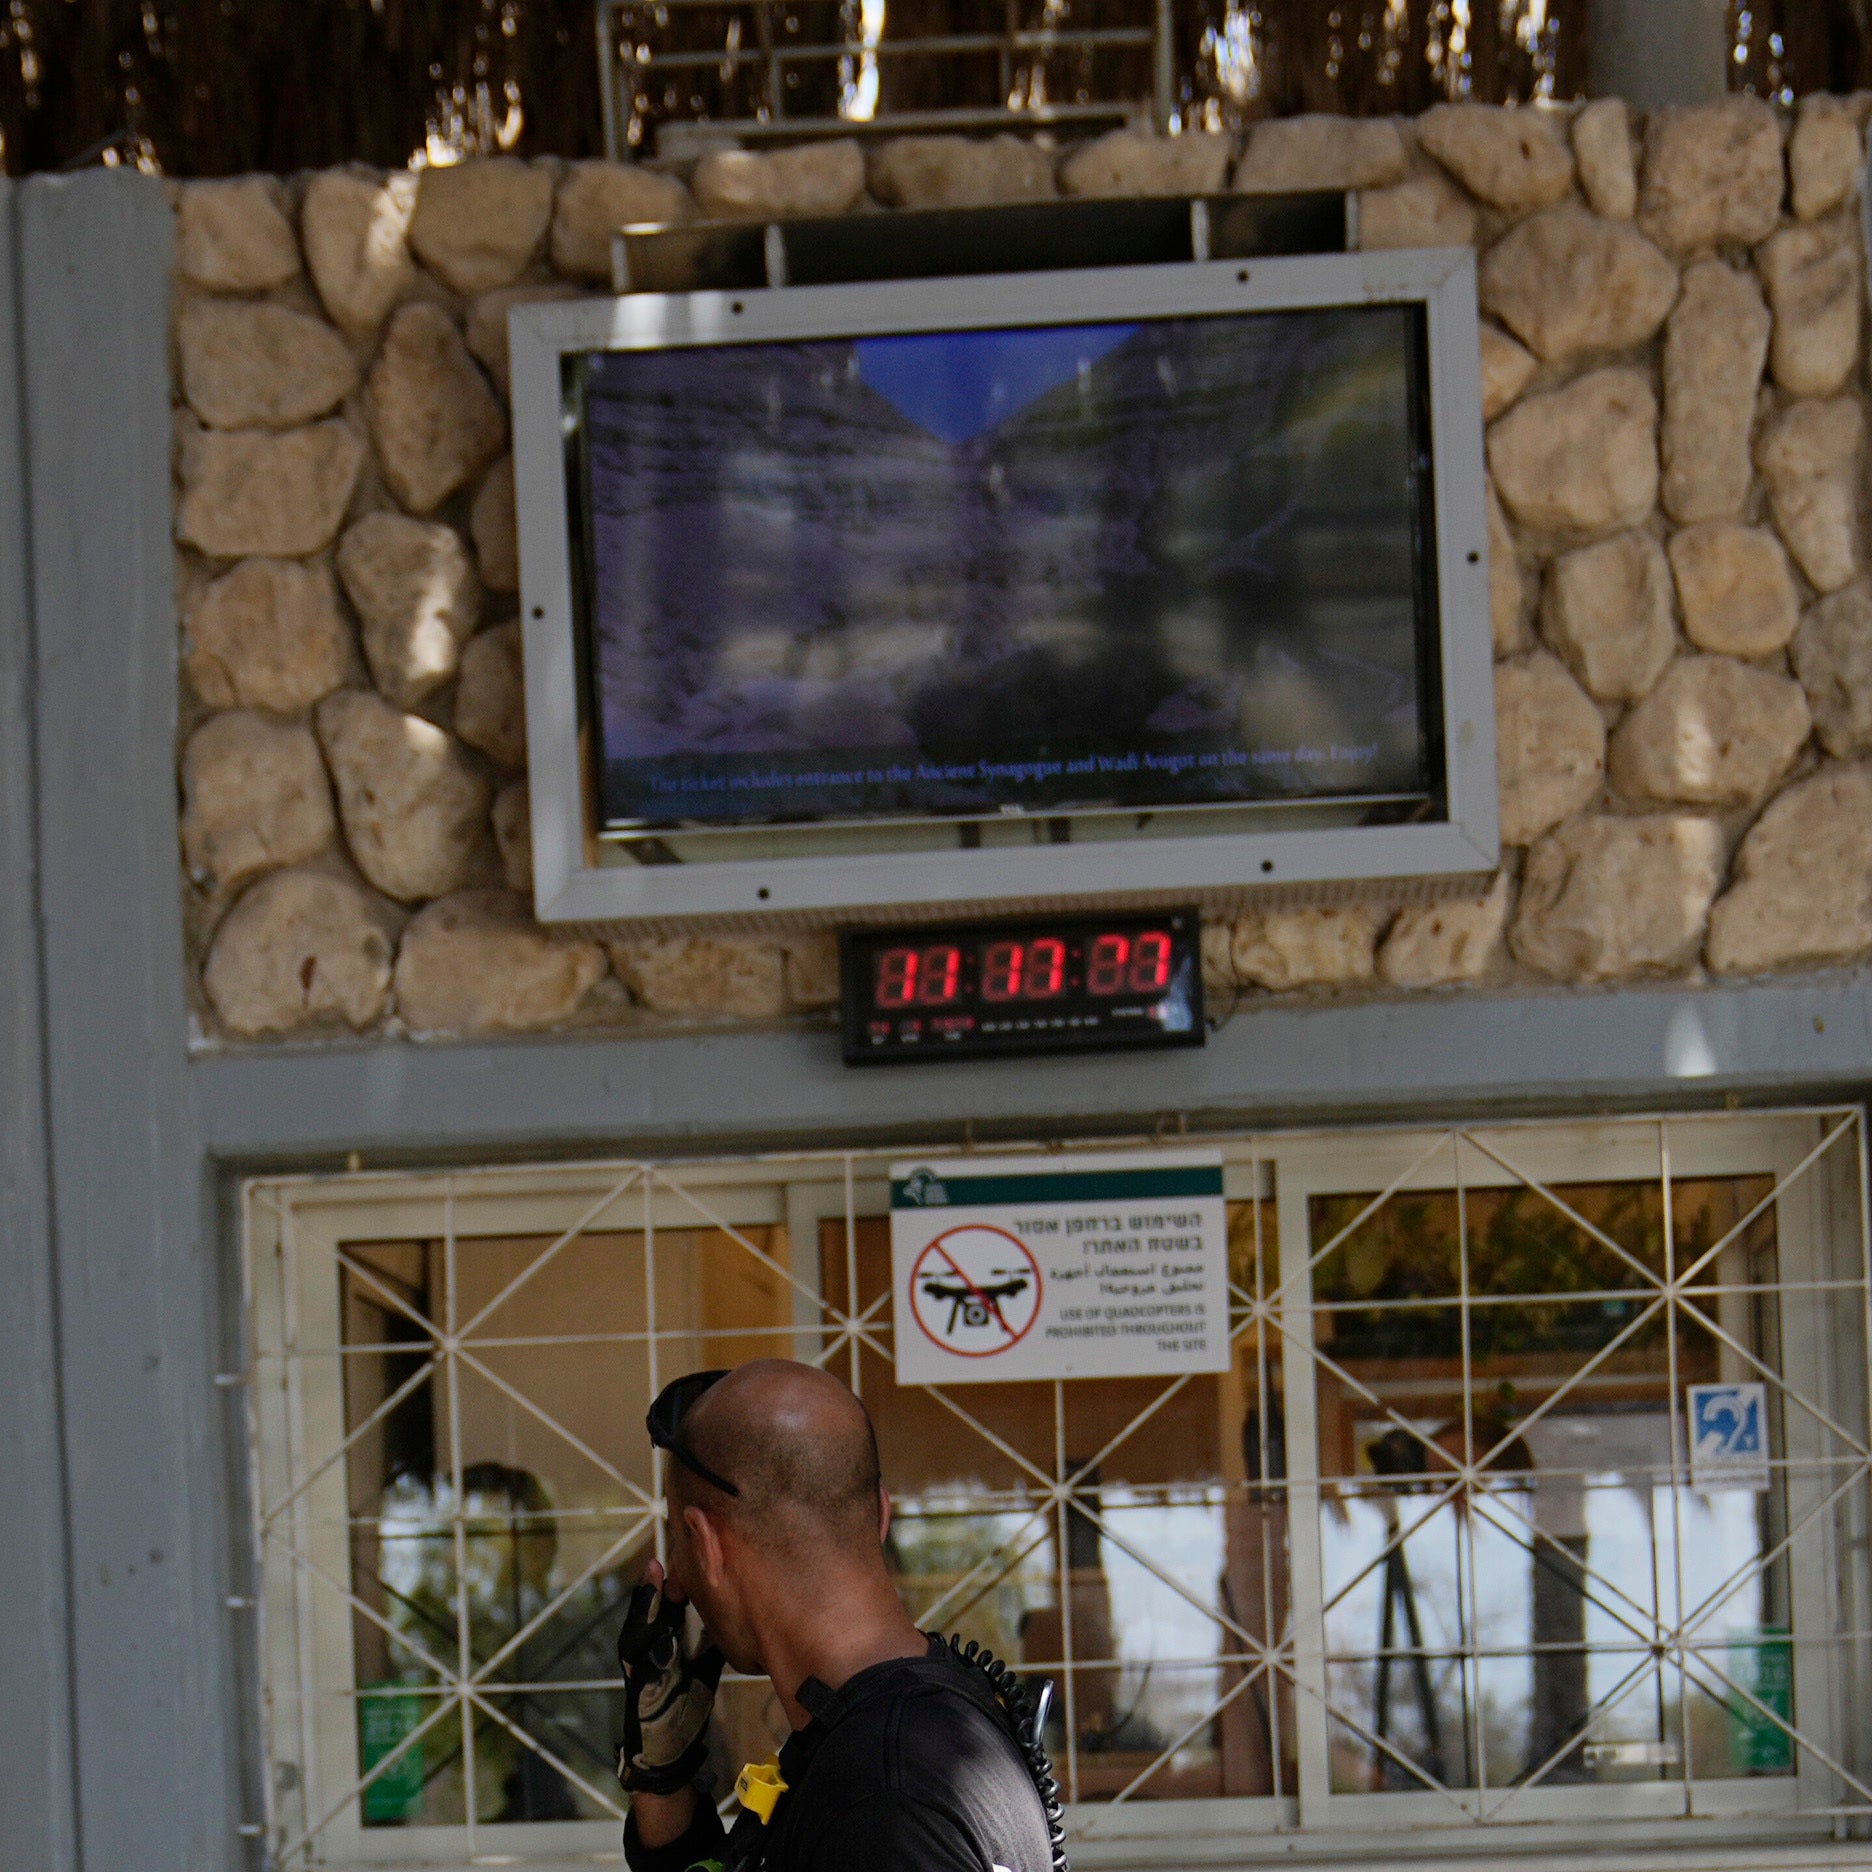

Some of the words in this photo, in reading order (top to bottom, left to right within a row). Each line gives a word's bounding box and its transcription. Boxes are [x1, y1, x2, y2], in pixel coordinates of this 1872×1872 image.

[979, 757, 1062, 784] Synagogue
[1066, 753, 1095, 773] and
[1014, 1219, 1059, 1234] אסור
[1129, 1213, 1202, 1230] השימוש
